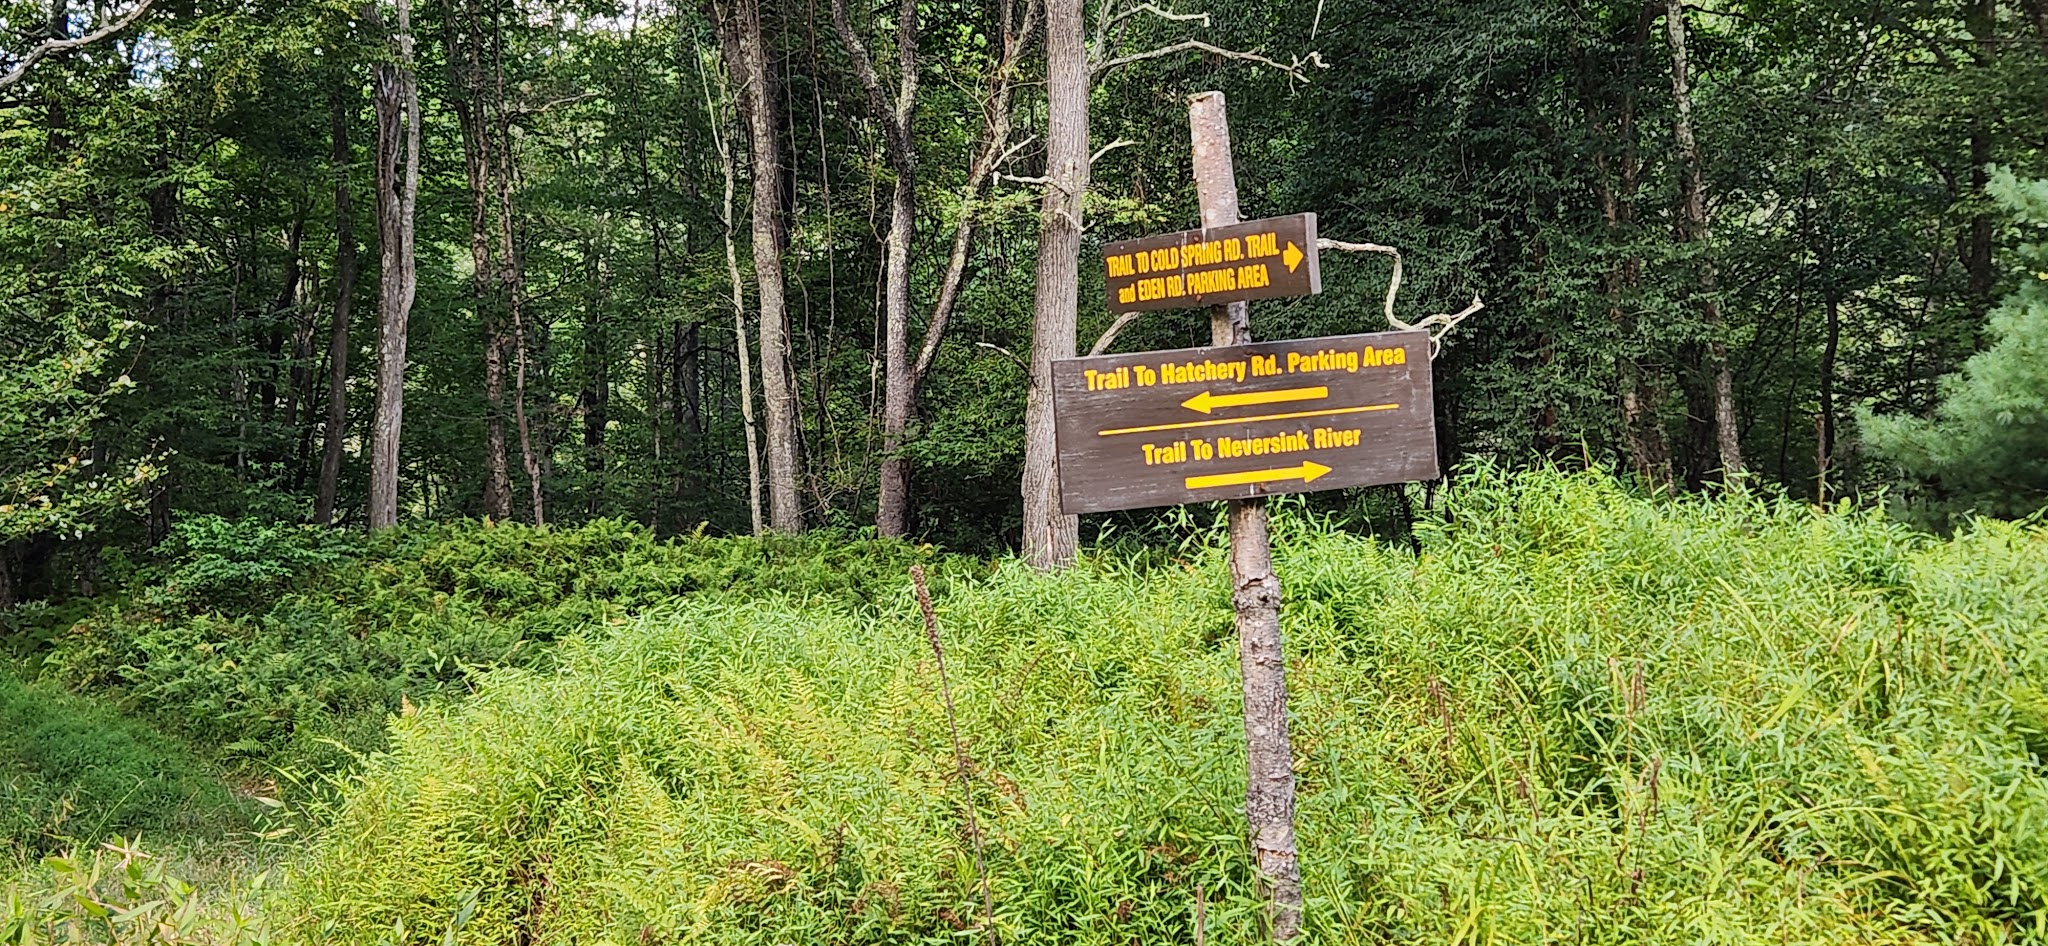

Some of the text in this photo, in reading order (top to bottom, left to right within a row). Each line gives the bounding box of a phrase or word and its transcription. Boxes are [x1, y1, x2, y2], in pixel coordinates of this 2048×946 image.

[1106, 232, 1280, 278] TRAIL TO COLD SPRING RD. TRAIL
[1118, 263, 1270, 304] and EDEN RD. PARKING AREA
[1084, 345, 1406, 391] Trail To Hatchery Rd. Parking Area
[1141, 427, 1361, 466] Trail To Neversink River
